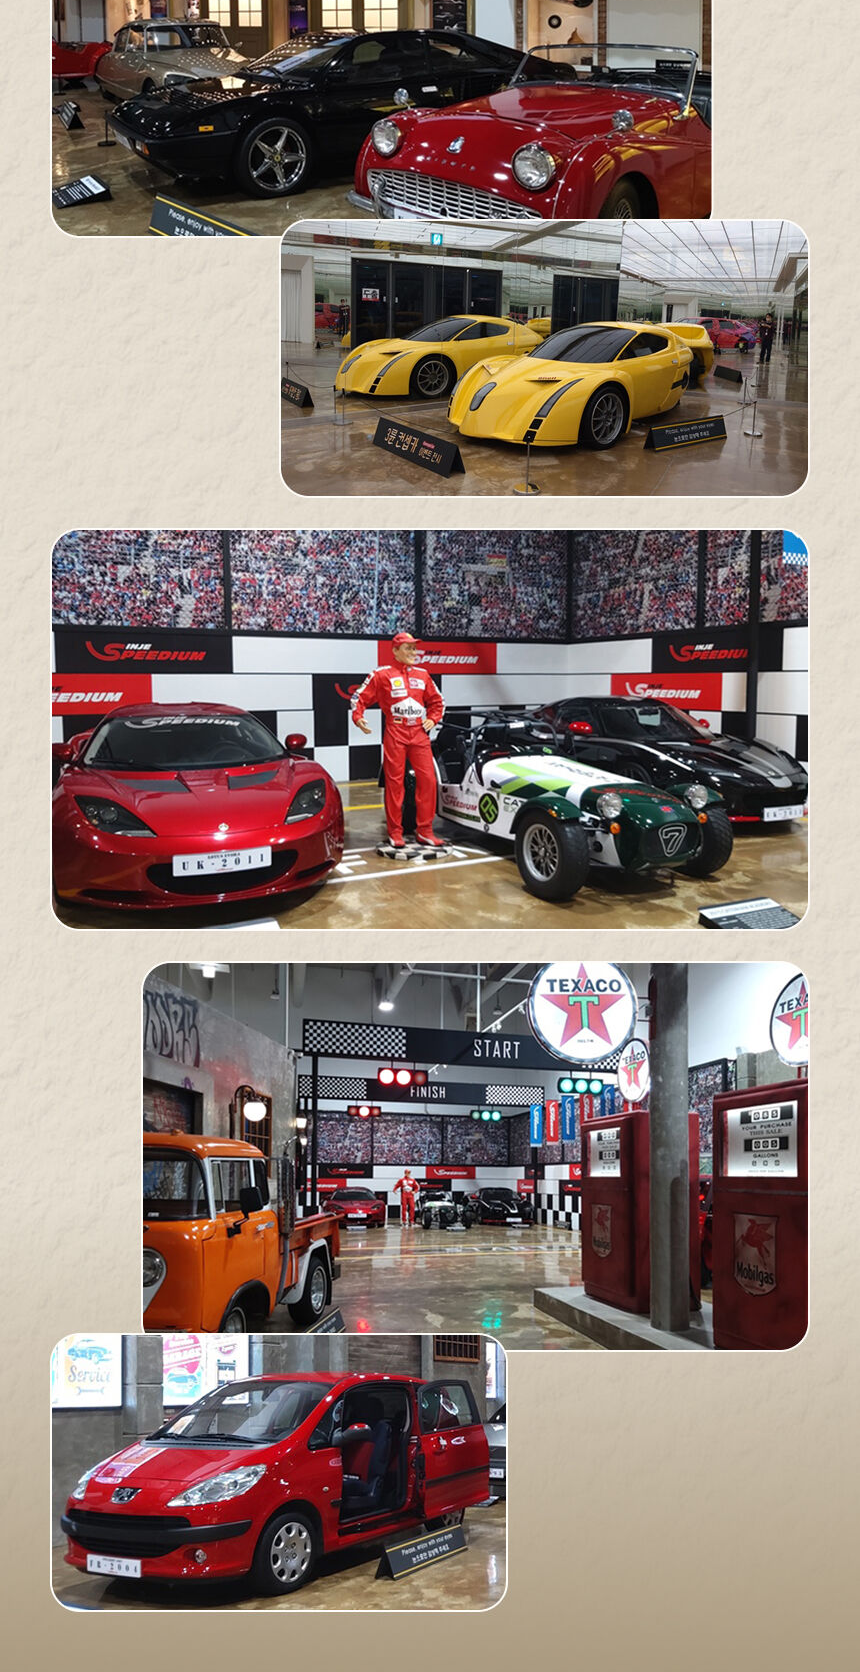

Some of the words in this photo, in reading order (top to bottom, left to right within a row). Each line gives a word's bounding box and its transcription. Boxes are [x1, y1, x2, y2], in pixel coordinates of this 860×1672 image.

[86, 641, 206, 662] SPEEDIUM
[625, 682, 701, 699] SPEEDIUM
[124, 716, 240, 730] SPEEDIUM
[182, 853, 264, 871] UK-2011
[546, 979, 622, 993] TEXACO
[474, 1039, 520, 1059] START
[410, 1086, 446, 1099] FINISH
